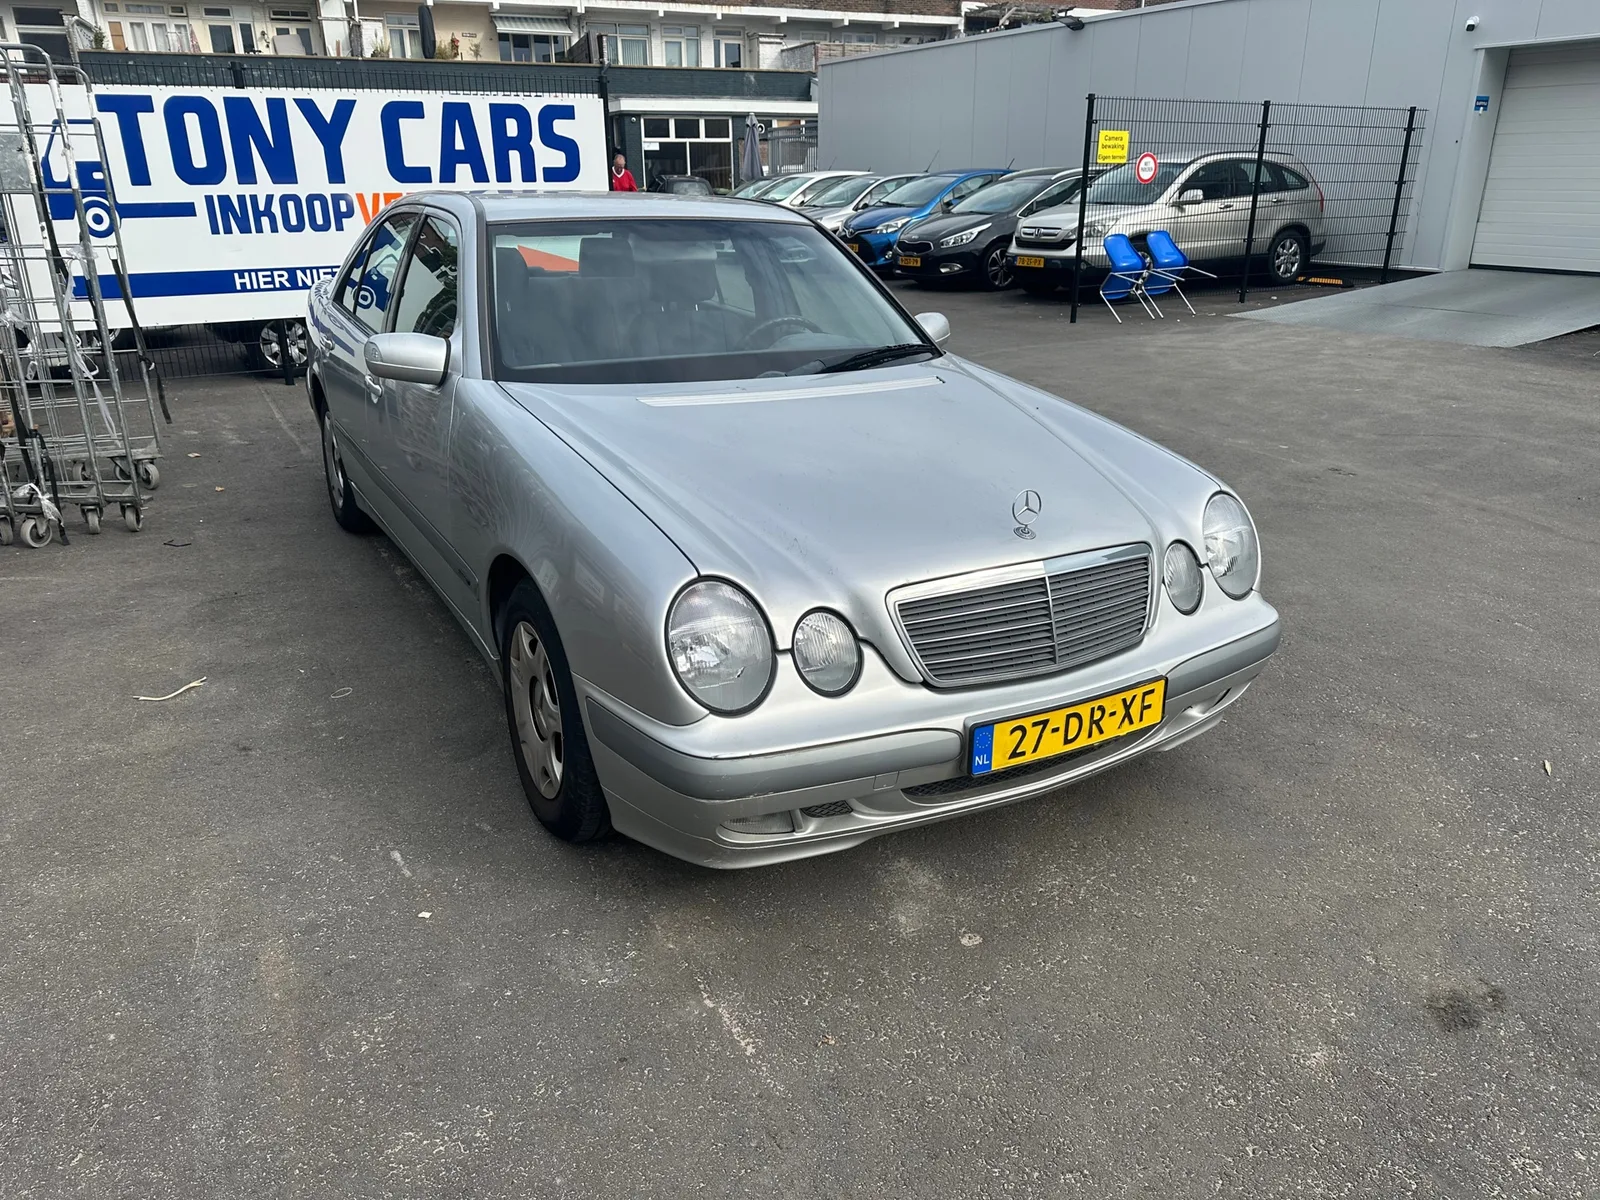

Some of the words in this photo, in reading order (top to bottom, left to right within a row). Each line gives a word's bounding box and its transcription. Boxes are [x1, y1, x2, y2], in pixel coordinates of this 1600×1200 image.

[94, 94, 357, 186] TONY
[381, 101, 581, 184] CARS
[1104, 134, 1123, 142] Camera
[233, 270, 292, 290] HIER
[295, 267, 340, 287] NIE
[974, 755, 990, 767] NL
[1008, 689, 1155, 760] 27-DR-XF
